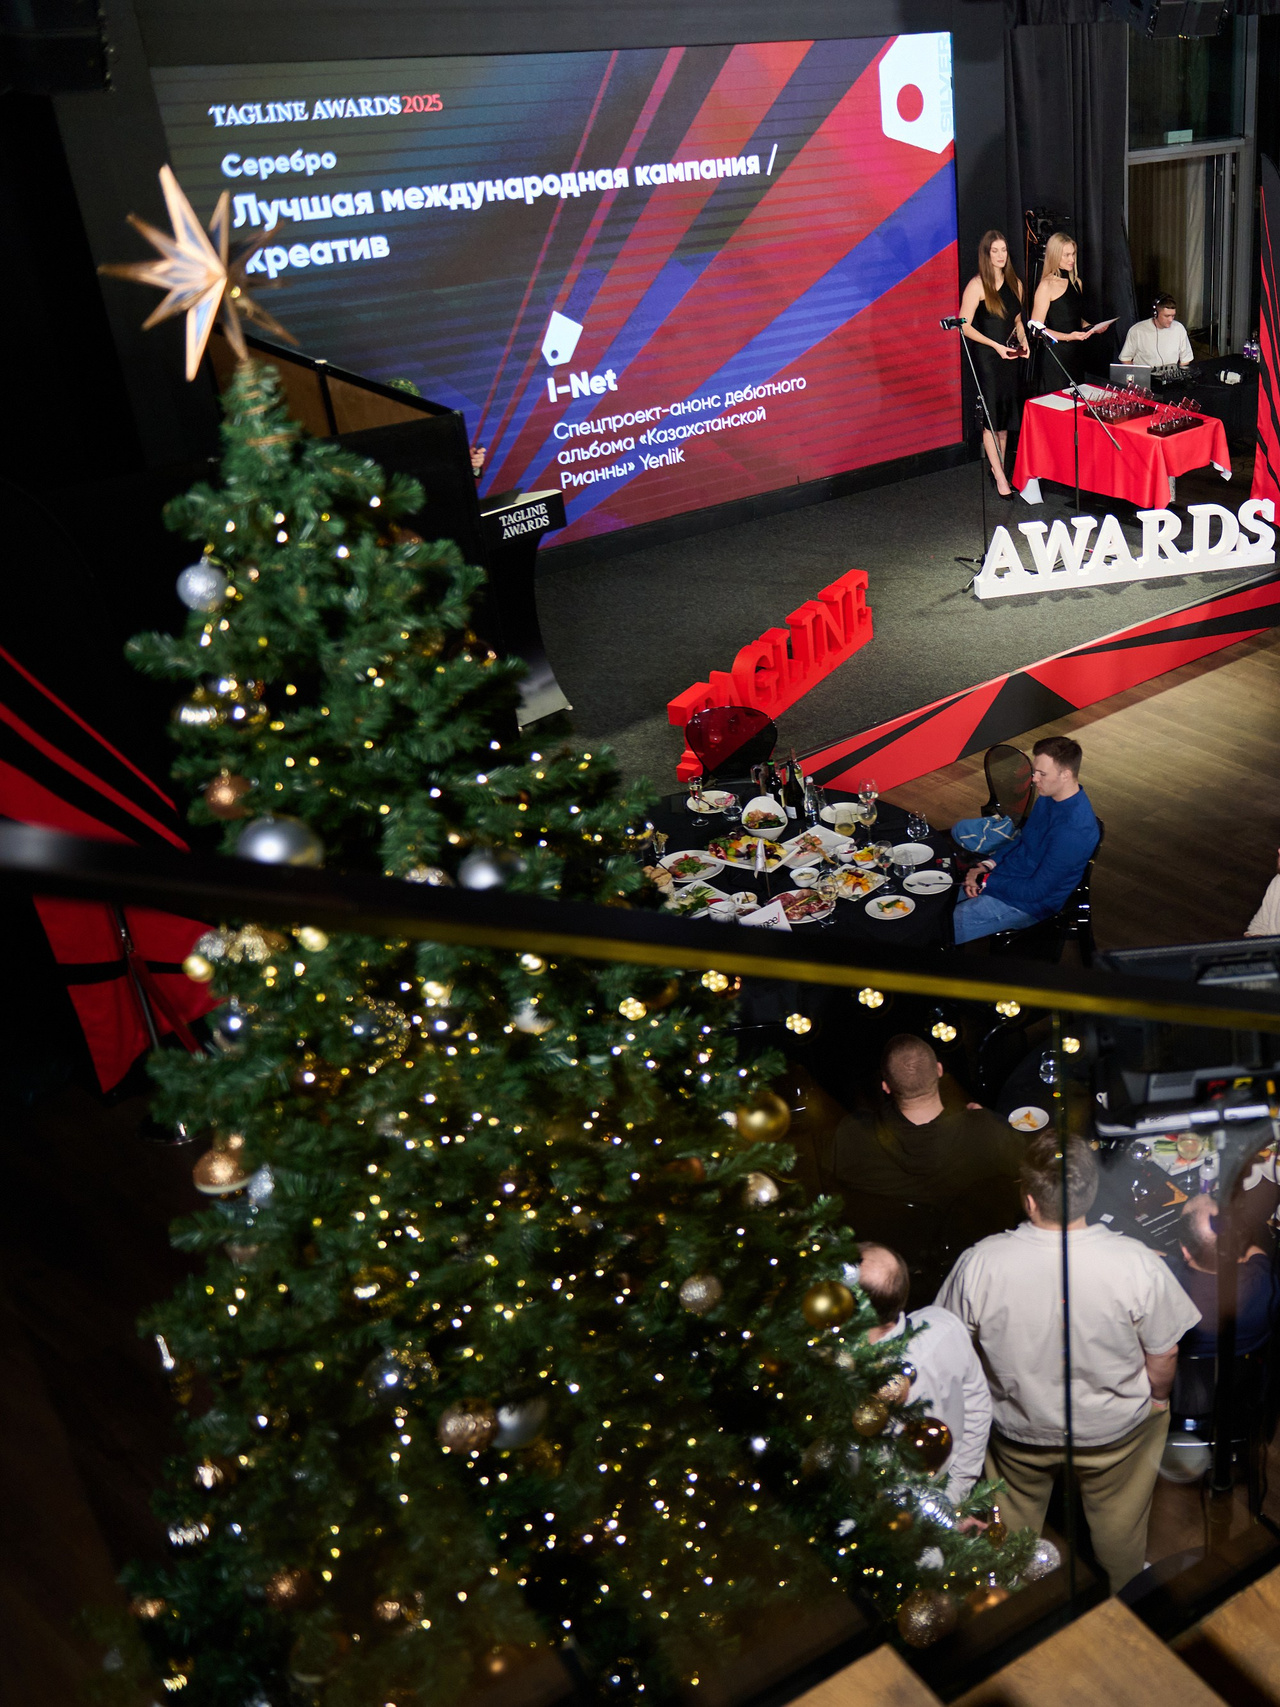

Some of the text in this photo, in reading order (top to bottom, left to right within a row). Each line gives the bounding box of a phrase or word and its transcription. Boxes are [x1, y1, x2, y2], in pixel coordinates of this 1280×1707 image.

[208, 101, 309, 127] TAGLINE
[221, 148, 337, 180] Серебро
[232, 190, 375, 231] Лучшая
[381, 167, 629, 213] международная
[635, 154, 761, 186] кампания
[553, 376, 807, 440] Спецпроект-анонс дебютного
[557, 406, 766, 465] альбома «Казахстанской
[560, 447, 686, 489] Рианны» Yenlik
[499, 503, 548, 527] TAGLINE
[502, 514, 551, 540] AWARDS
[980, 499, 1275, 585] AWARDS
